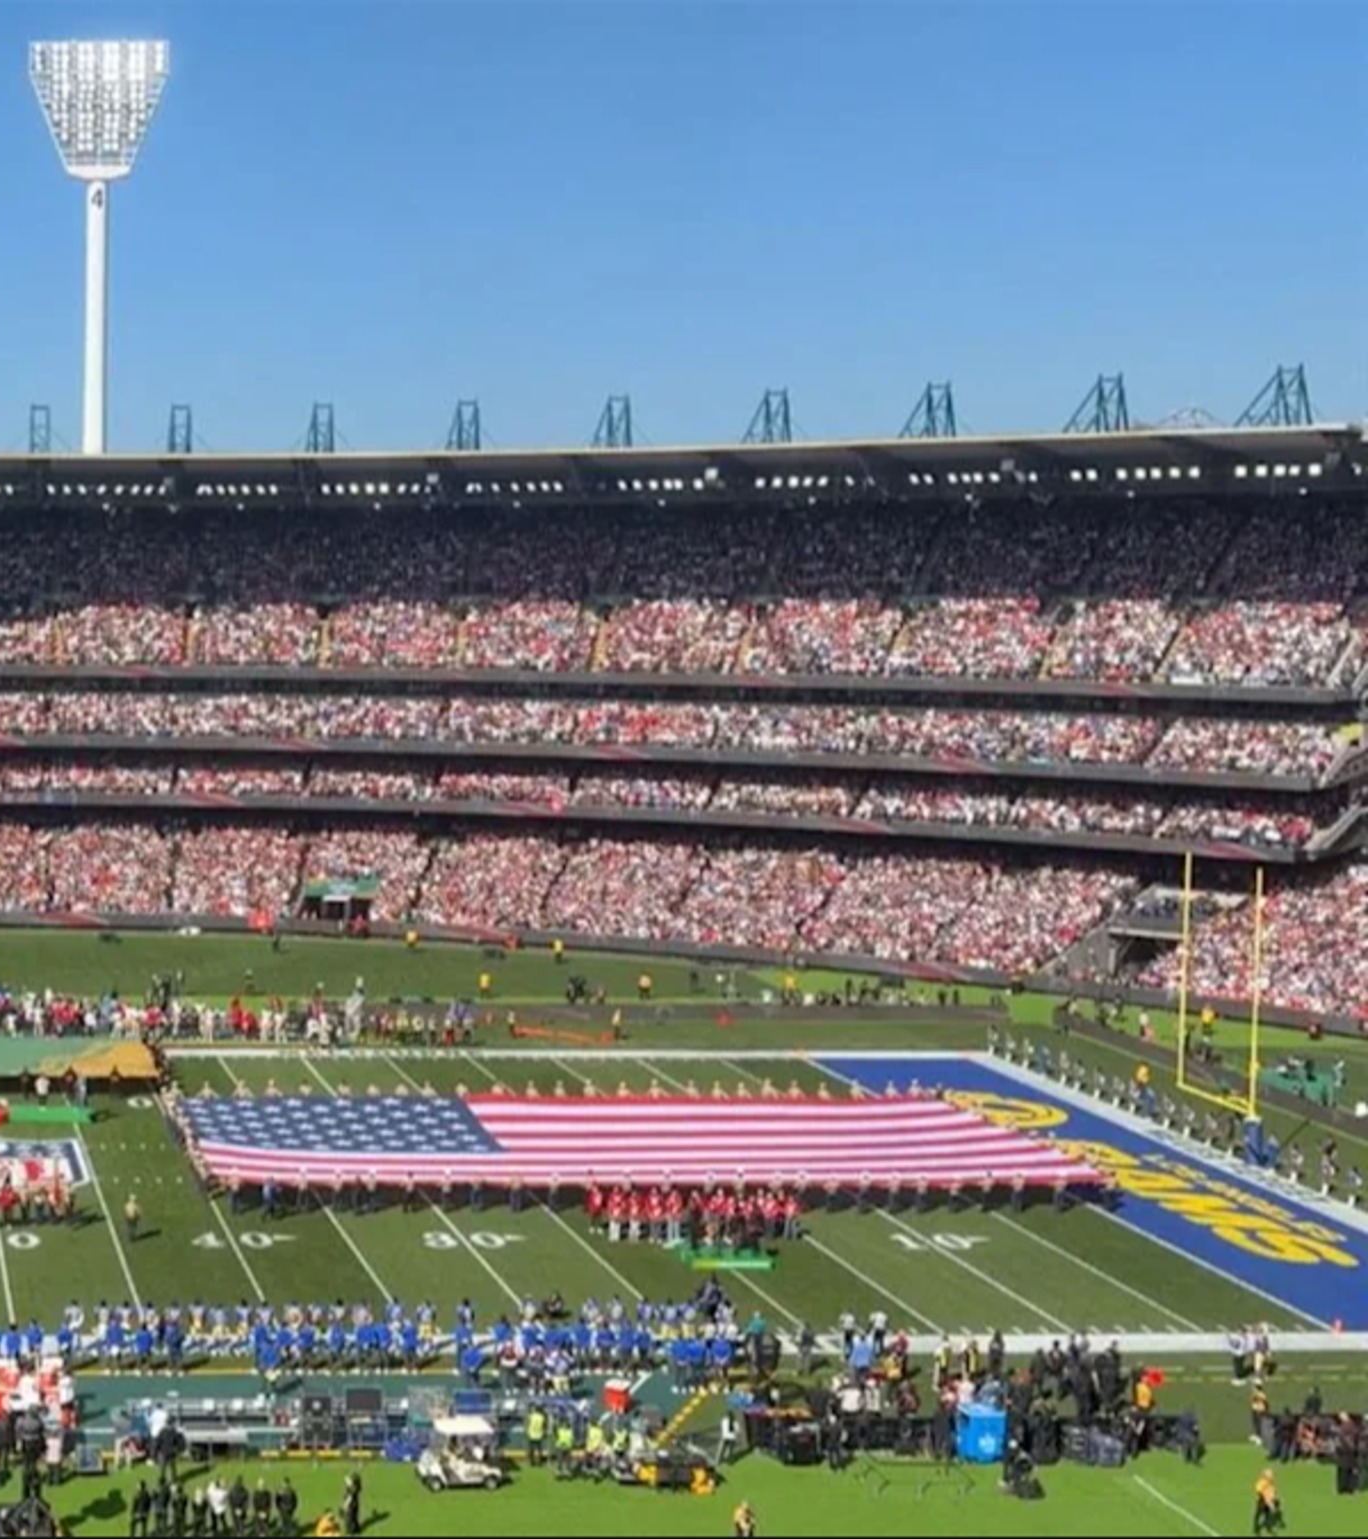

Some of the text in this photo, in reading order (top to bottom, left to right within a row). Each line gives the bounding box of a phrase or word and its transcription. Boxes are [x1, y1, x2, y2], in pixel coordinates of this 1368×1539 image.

[90, 187, 104, 209] 4
[191, 1231, 274, 1249] 40
[422, 1231, 507, 1249] 30
[890, 1233, 973, 1250] 10
